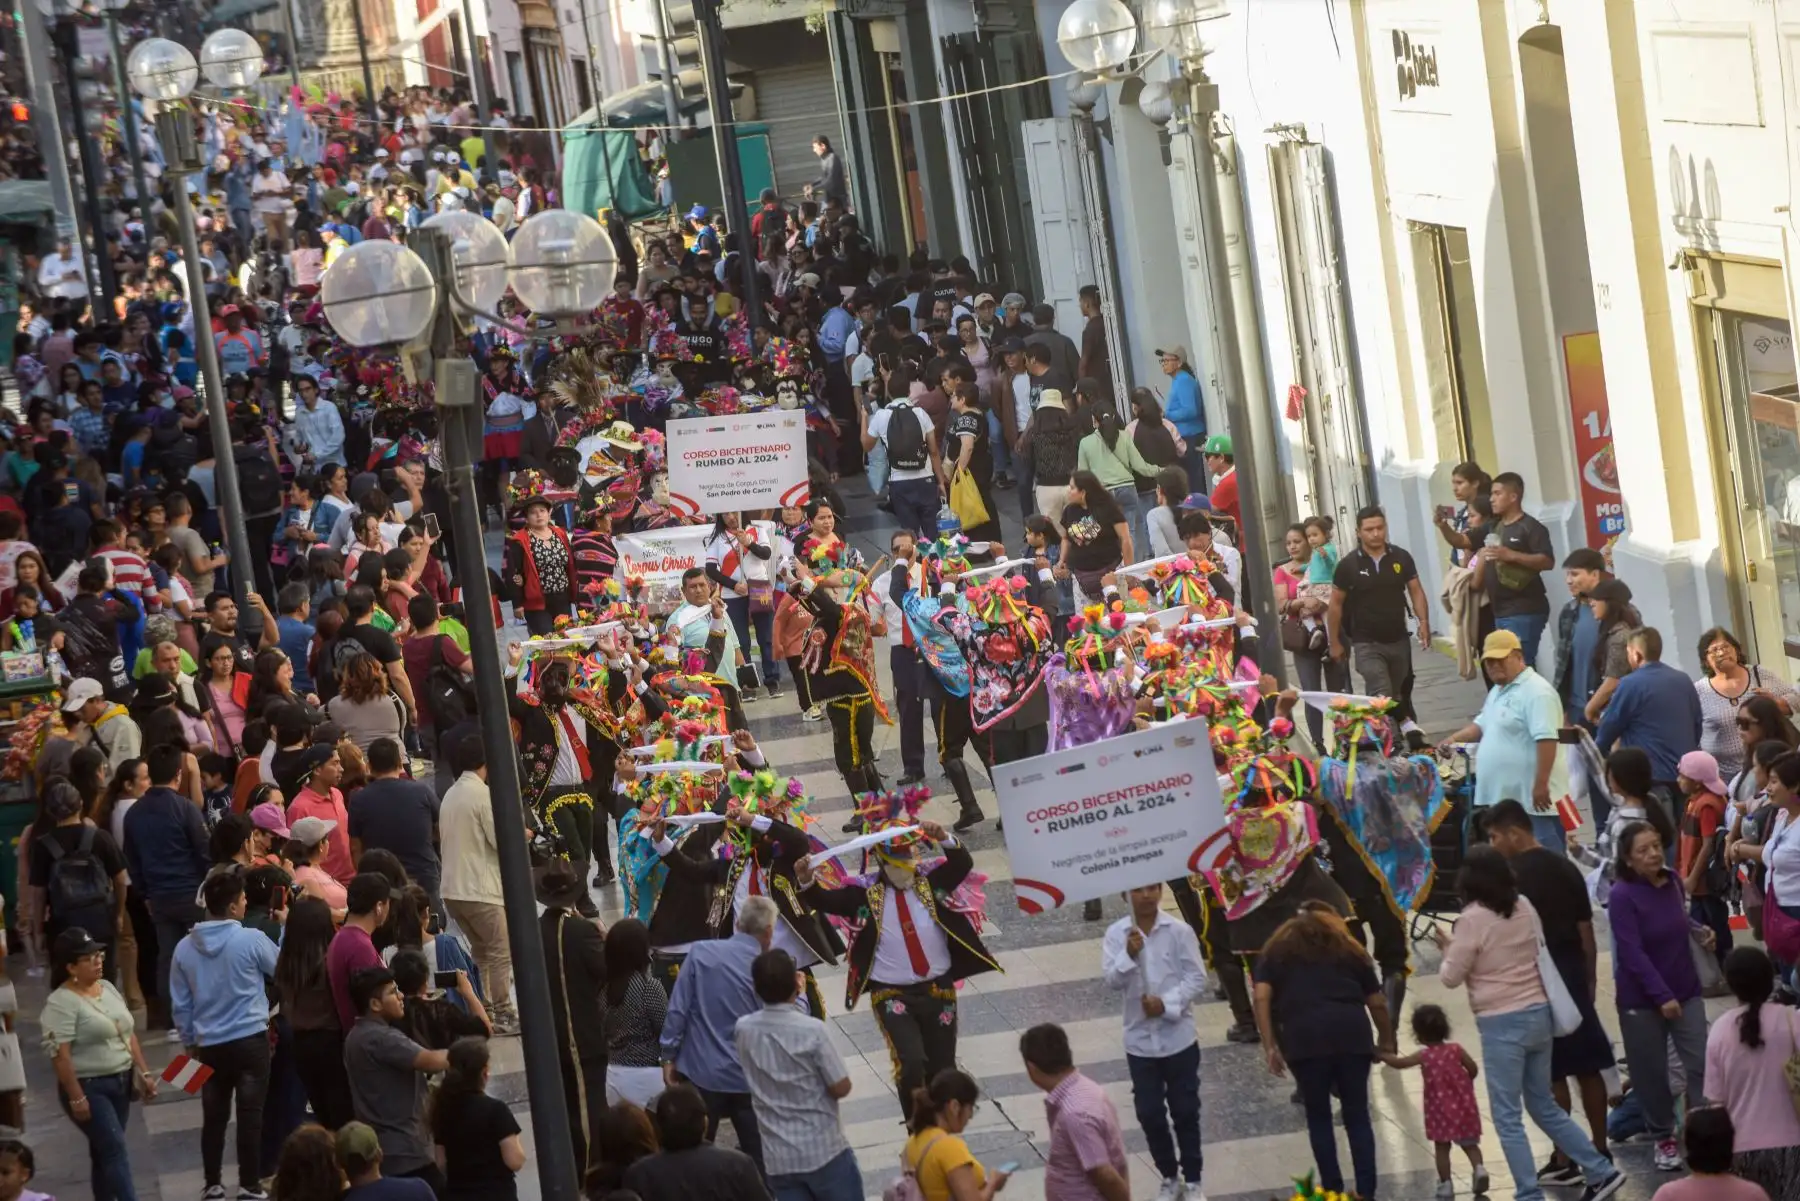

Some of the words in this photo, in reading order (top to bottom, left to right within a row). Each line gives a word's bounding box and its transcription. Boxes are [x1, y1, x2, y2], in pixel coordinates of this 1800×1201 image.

[683, 450, 718, 460] CORSO
[720, 443, 791, 457] BICENTENARIO
[695, 457, 735, 468] RUMBO
[737, 456, 751, 465] AL
[754, 454, 779, 464] 2024
[698, 483, 726, 491] Negritos
[736, 480, 758, 488] Corpus
[720, 489, 741, 497] Pedro
[1596, 503, 1624, 517] Mo
[1606, 517, 1625, 531] Br
[624, 554, 660, 576] Corpus
[661, 554, 696, 573] Christi
[1026, 800, 1079, 823] CORSO
[1082, 773, 1193, 810] BICENTENARIO
[1047, 809, 1108, 833] RUMBO
[1112, 805, 1134, 818] AL
[1138, 792, 1176, 811] 2024
[1051, 852, 1093, 869] Negritos
[1094, 848, 1106, 858] de
[1108, 846, 1117, 855] la
[1119, 839, 1149, 851] limpia
[1150, 829, 1188, 845] acequia
[1080, 859, 1120, 875] Colonia
[1121, 848, 1164, 866] Pampas
